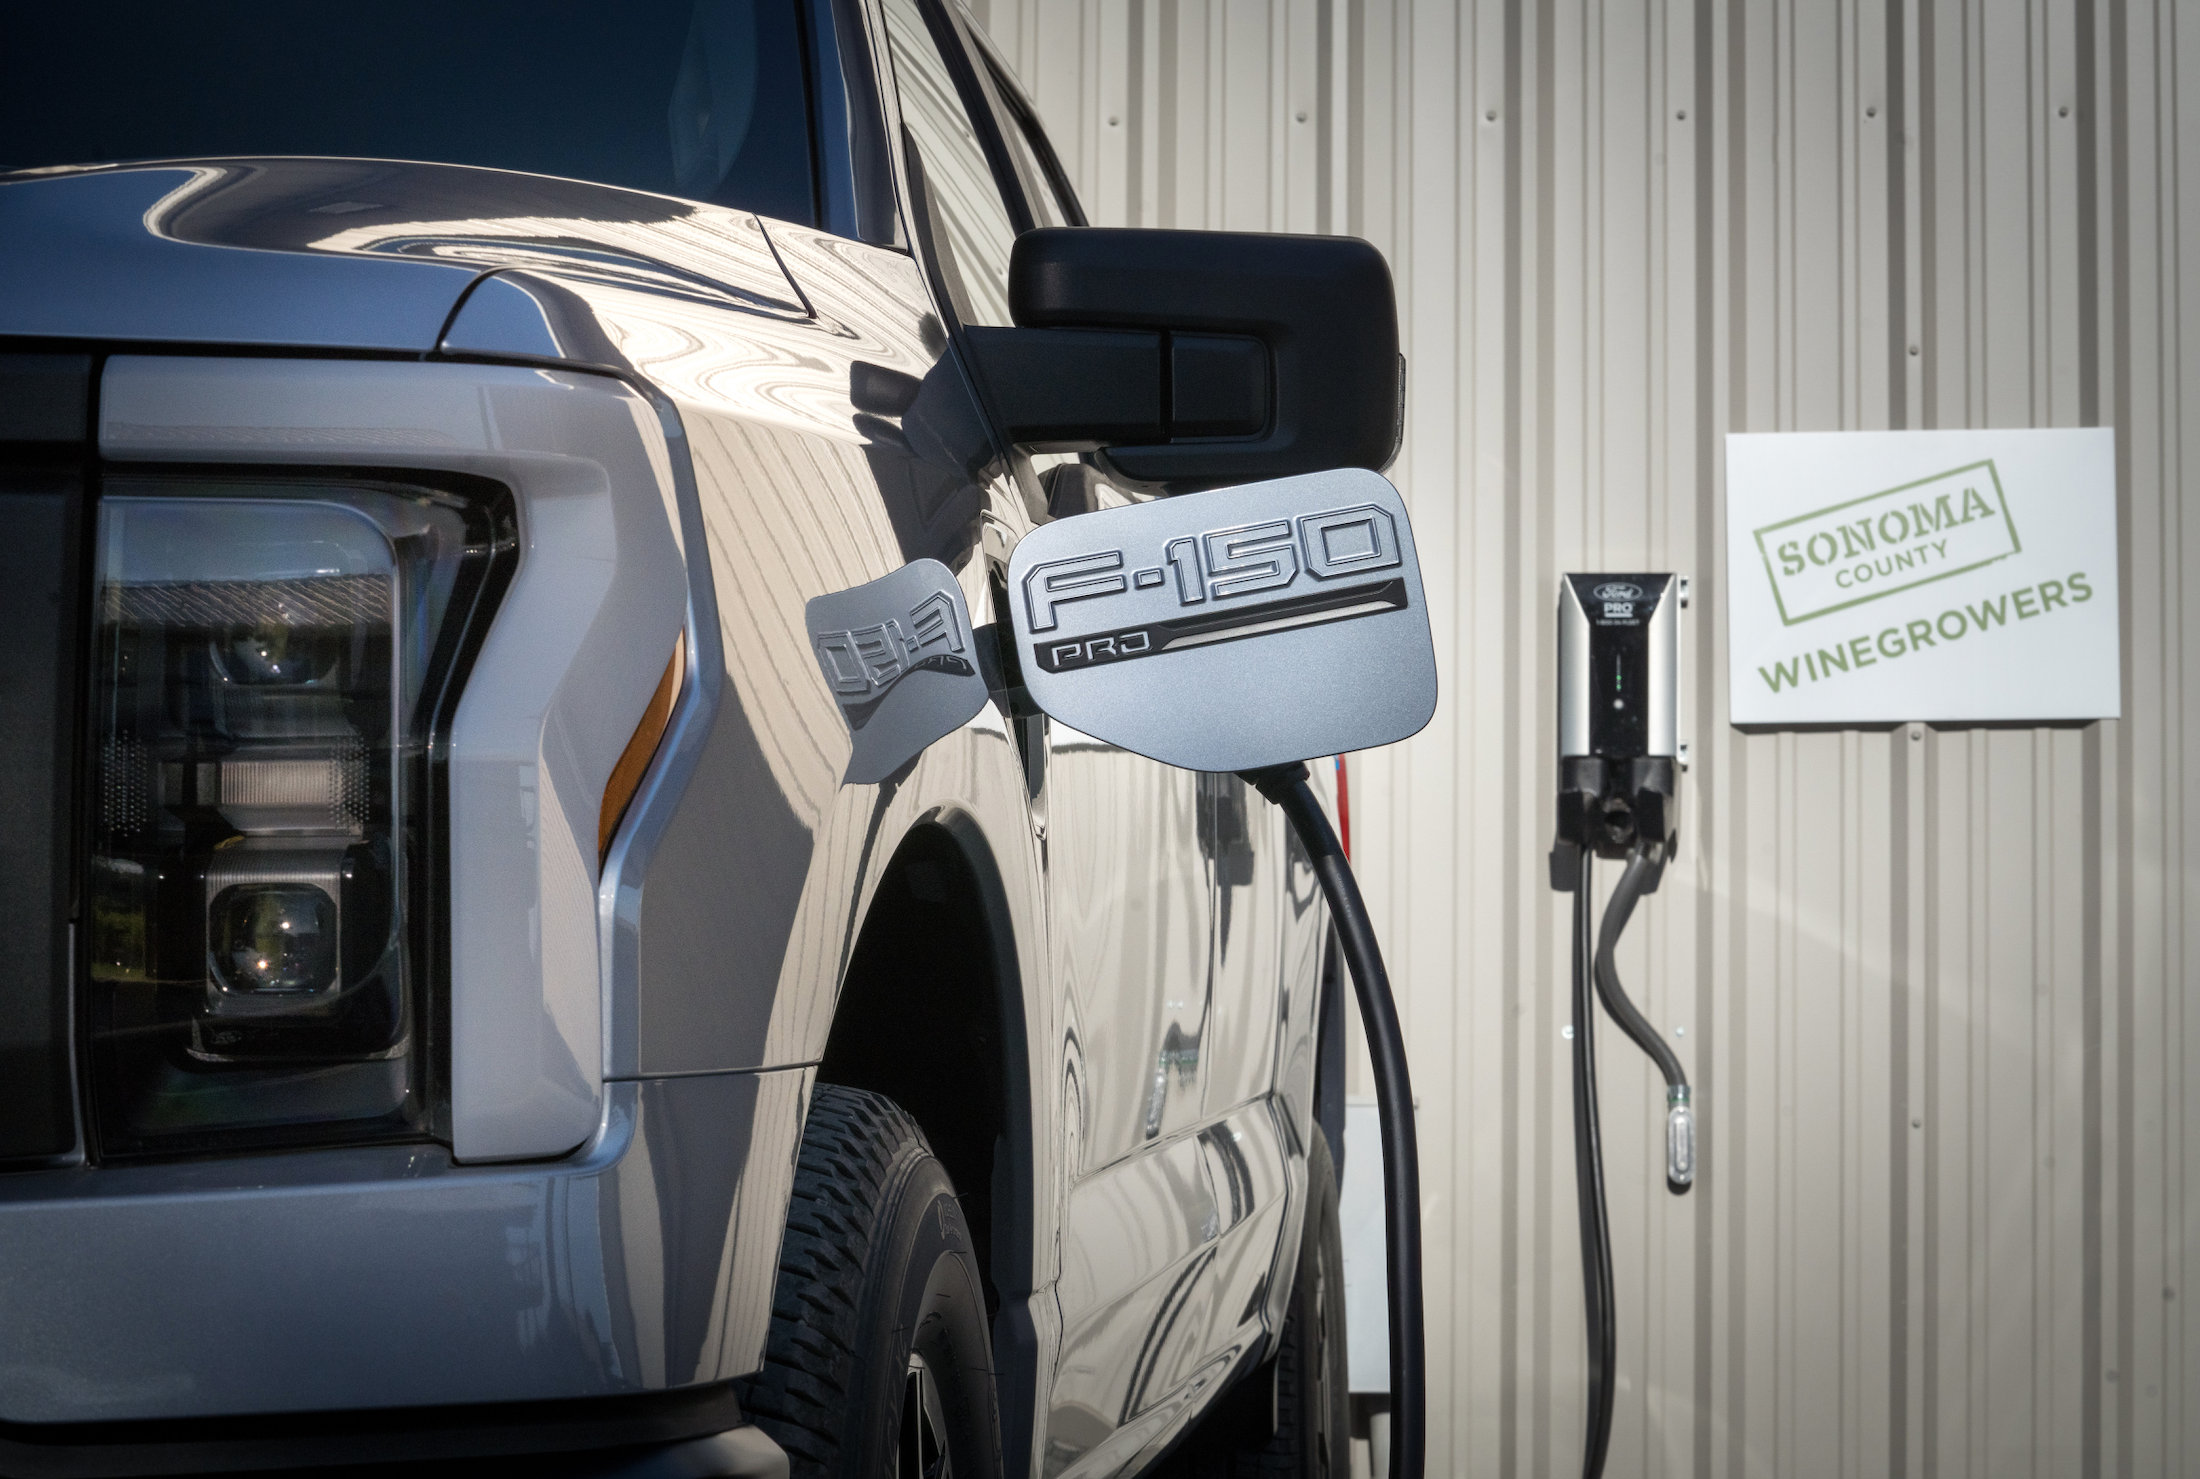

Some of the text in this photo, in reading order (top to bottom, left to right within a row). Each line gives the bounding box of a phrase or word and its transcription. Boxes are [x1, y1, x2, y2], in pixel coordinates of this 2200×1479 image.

[1778, 487, 1996, 576] SONOMA
[1023, 503, 1403, 634] F-150
[1835, 539, 1948, 588] COUNTY
[1601, 584, 1635, 599] Ford
[1603, 601, 1634, 614] PRO
[1051, 631, 1153, 667] PRO
[1758, 572, 2093, 693] WINEGROWERS
